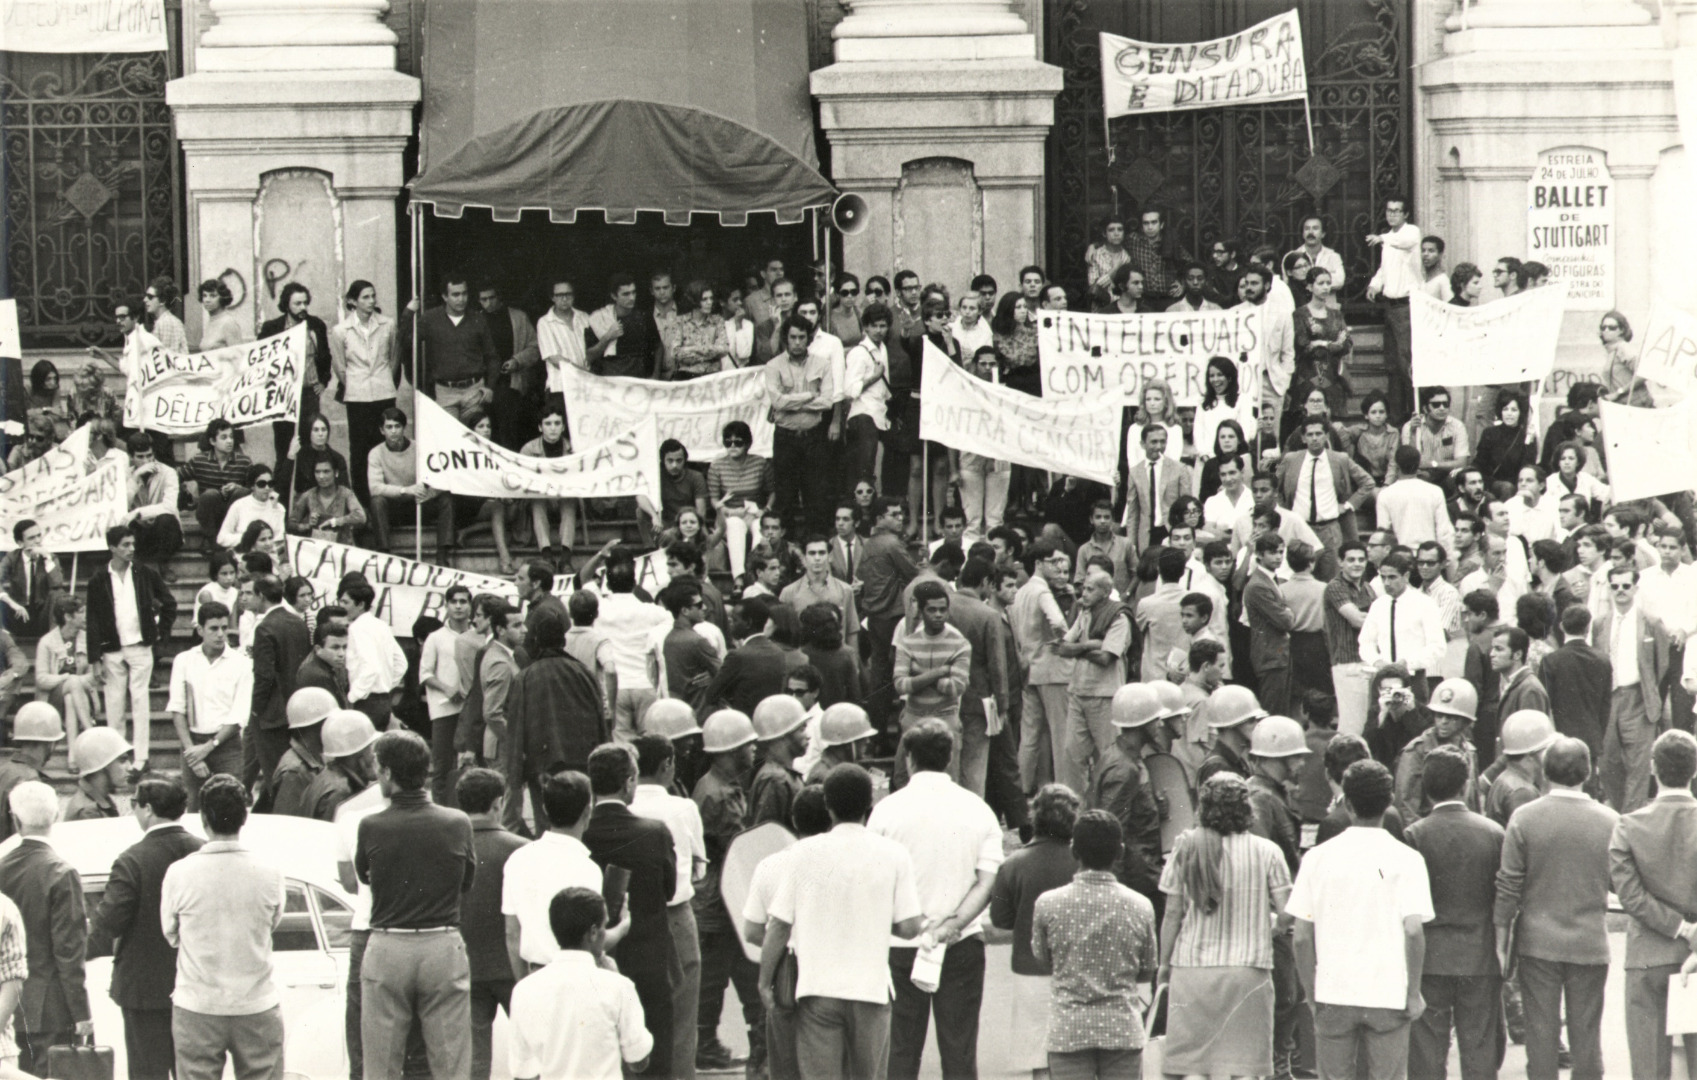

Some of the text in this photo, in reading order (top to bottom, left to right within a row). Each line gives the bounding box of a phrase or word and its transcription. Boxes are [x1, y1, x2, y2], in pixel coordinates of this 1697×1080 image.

[1115, 21, 1295, 76] CENSURA
[1174, 58, 1302, 105] DITADURA
[1548, 155, 1594, 165] ESTREIA
[1541, 167, 1599, 180] 24 DE JULHO
[1534, 185, 1608, 208] BALLET
[1560, 213, 1580, 222] DE
[1533, 224, 1609, 249] STUTTGART
[1563, 264, 1606, 278] FIGURAS
[1056, 310, 1257, 356] INTELECTUAIS
[1048, 365, 1104, 394] COM
[155, 393, 215, 424] DÊLES
